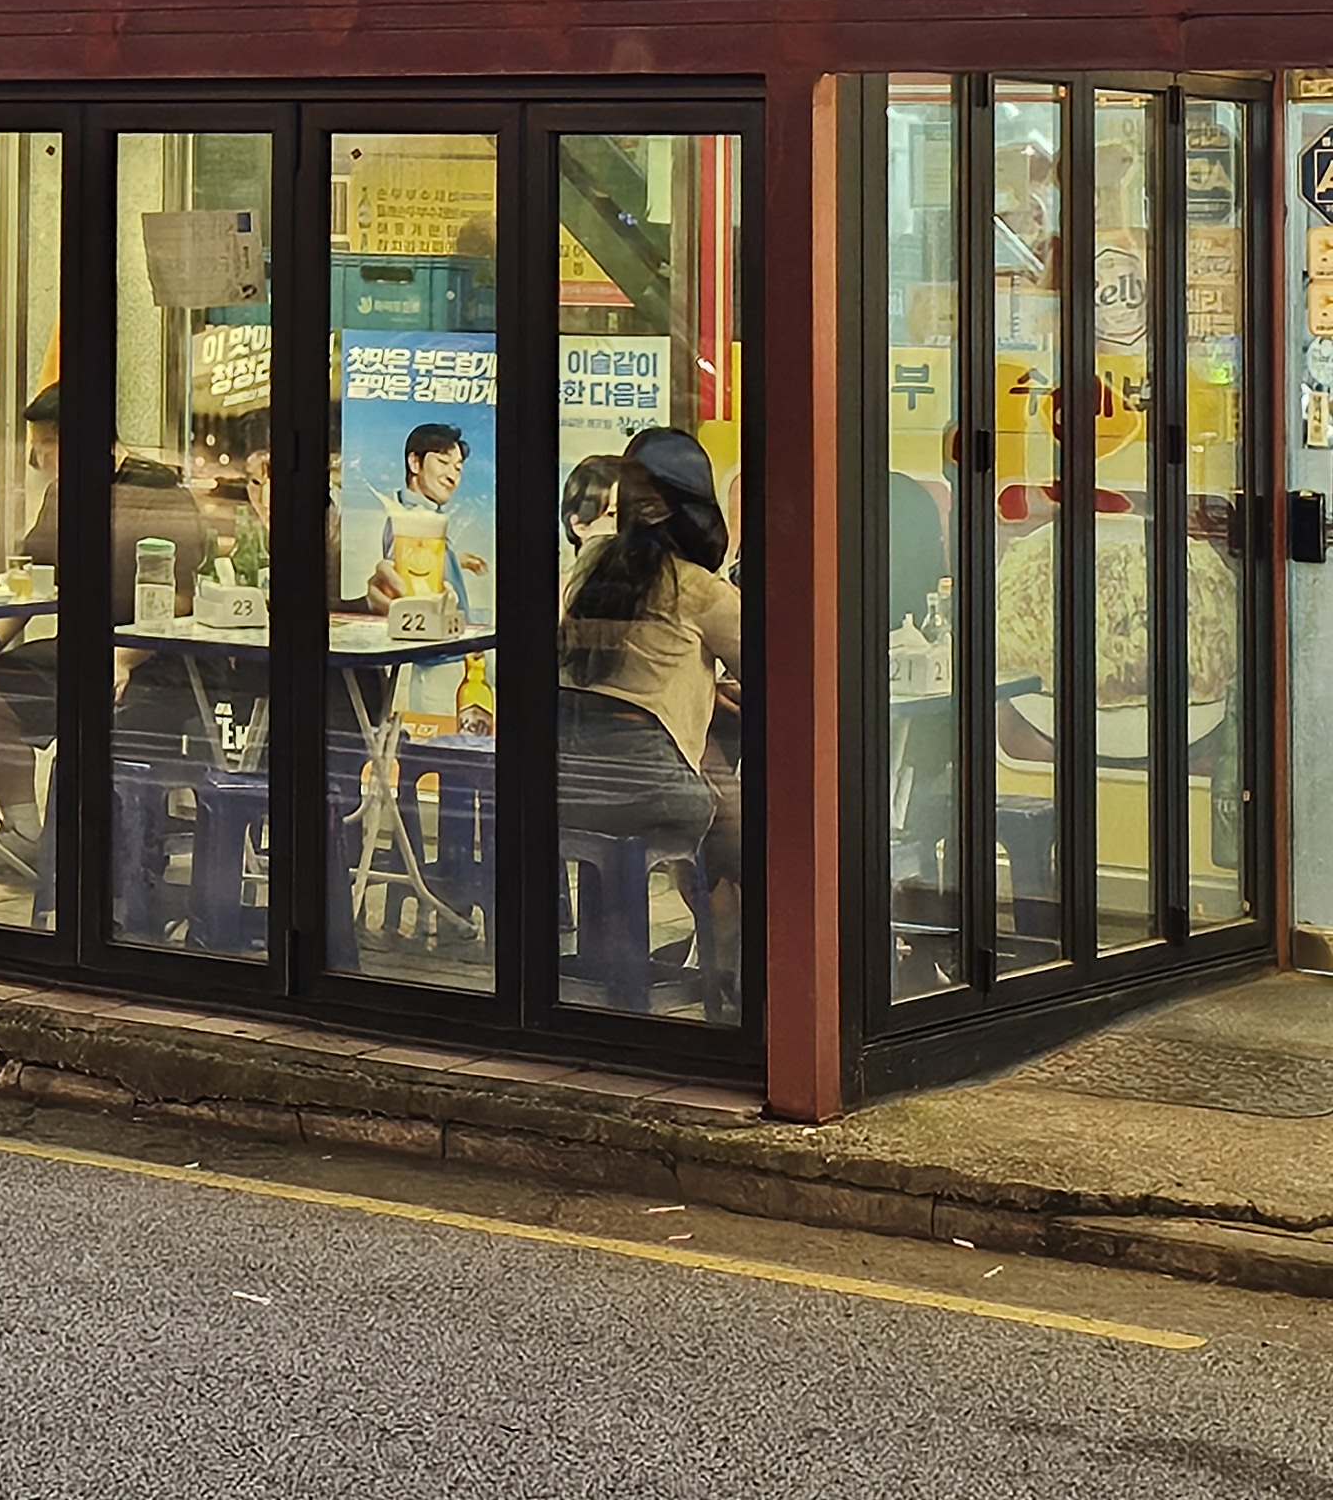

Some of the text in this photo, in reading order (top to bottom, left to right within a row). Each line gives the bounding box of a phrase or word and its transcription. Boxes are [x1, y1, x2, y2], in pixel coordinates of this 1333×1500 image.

[202, 331, 225, 364] 이
[346, 346, 497, 378] 첫맛은 부드럽게
[567, 350, 659, 378] 이슬같이
[589, 381, 660, 409] 다음날
[233, 600, 254, 617] 23
[401, 613, 427, 632] 22
